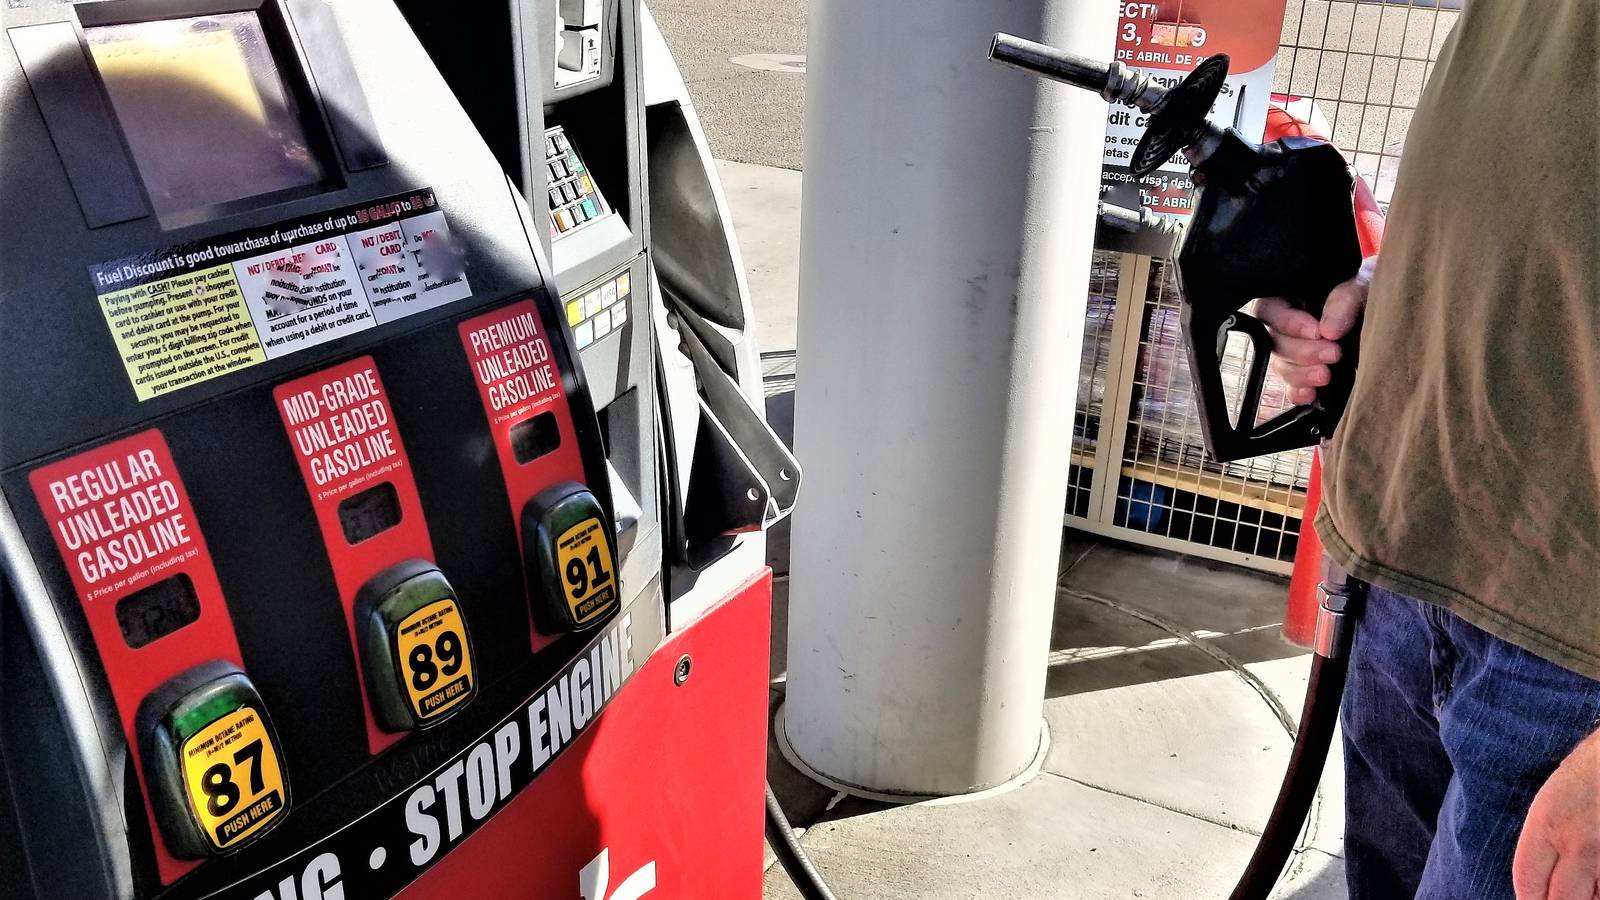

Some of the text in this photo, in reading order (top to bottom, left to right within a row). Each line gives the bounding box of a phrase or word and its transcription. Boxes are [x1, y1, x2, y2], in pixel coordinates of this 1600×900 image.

[1122, 23, 1142, 45] 3,
[1117, 50, 1192, 64] DE ABRIL DE
[1105, 135, 1119, 145] os
[1143, 195, 1159, 205] DE
[96, 267, 123, 285] Fuel
[123, 256, 175, 280] Discount
[176, 253, 185, 267] is
[186, 246, 215, 267] good
[270, 231, 280, 244] of
[324, 217, 334, 230] of
[335, 216, 348, 233] up
[349, 214, 358, 225] to
[400, 201, 411, 211] to
[315, 242, 336, 254] CARD
[380, 230, 401, 242] DEBIT
[380, 243, 401, 256] CARD
[414, 234, 422, 243] Do
[105, 268, 230, 306] Paying with CASH? Please pay cashier
[109, 280, 235, 317] before pumping. Present shoppers
[328, 293, 337, 301] on
[338, 288, 352, 300] your
[115, 289, 238, 328] card to cashier or use with your credit
[121, 301, 240, 339] and debit card at the pump. For your
[271, 318, 296, 332] account
[297, 315, 307, 324] for
[314, 306, 335, 321] period
[336, 304, 343, 312] of
[343, 301, 358, 310] time
[126, 352, 144, 363] enter
[145, 348, 162, 360] your
[168, 338, 185, 352] digit
[186, 333, 207, 347] billing
[207, 329, 218, 340] zip
[218, 326, 234, 336] code
[235, 321, 252, 332] when
[130, 313, 240, 350] security, you may be requested to
[265, 336, 285, 348] when
[286, 330, 304, 342] using
[310, 322, 328, 335] debit
[337, 314, 354, 326] credit
[355, 309, 371, 320] card.
[469, 312, 538, 357] PREMIUM
[136, 341, 260, 386] cards issued outside the U.S., complete
[138, 359, 173, 373] prompted
[184, 348, 194, 359] the
[195, 343, 219, 355] screen.
[219, 338, 230, 347] For
[231, 333, 250, 344] credit
[477, 338, 549, 385] UNLEADED
[152, 382, 168, 394] your
[169, 370, 206, 386] transaction
[215, 362, 226, 371] the
[227, 355, 254, 369] window.
[488, 365, 556, 411] GASOLINE
[282, 368, 380, 426] MID-GRADE
[295, 399, 388, 456] UNLEADED
[310, 429, 396, 486] GASOLINE
[49, 448, 161, 513] REGULAR
[318, 493, 323, 501] $
[322, 487, 338, 498] Price
[338, 484, 348, 492] per
[348, 476, 366, 488] gallon
[58, 480, 180, 550] UNLEADED
[77, 514, 191, 584] GASOLINE
[87, 547, 199, 601] $ Price per gallon (including tax)
[566, 545, 610, 598] 91
[579, 591, 609, 615] PUSH HERE
[409, 631, 463, 691] 89
[425, 680, 465, 710] PUSH HERE
[215, 726, 235, 743] OCTANE
[235, 715, 255, 731] RATING
[405, 721, 520, 867] STOP
[528, 610, 635, 772] ENGINE
[201, 738, 265, 817] 87
[224, 797, 274, 837] PUSH HERE
